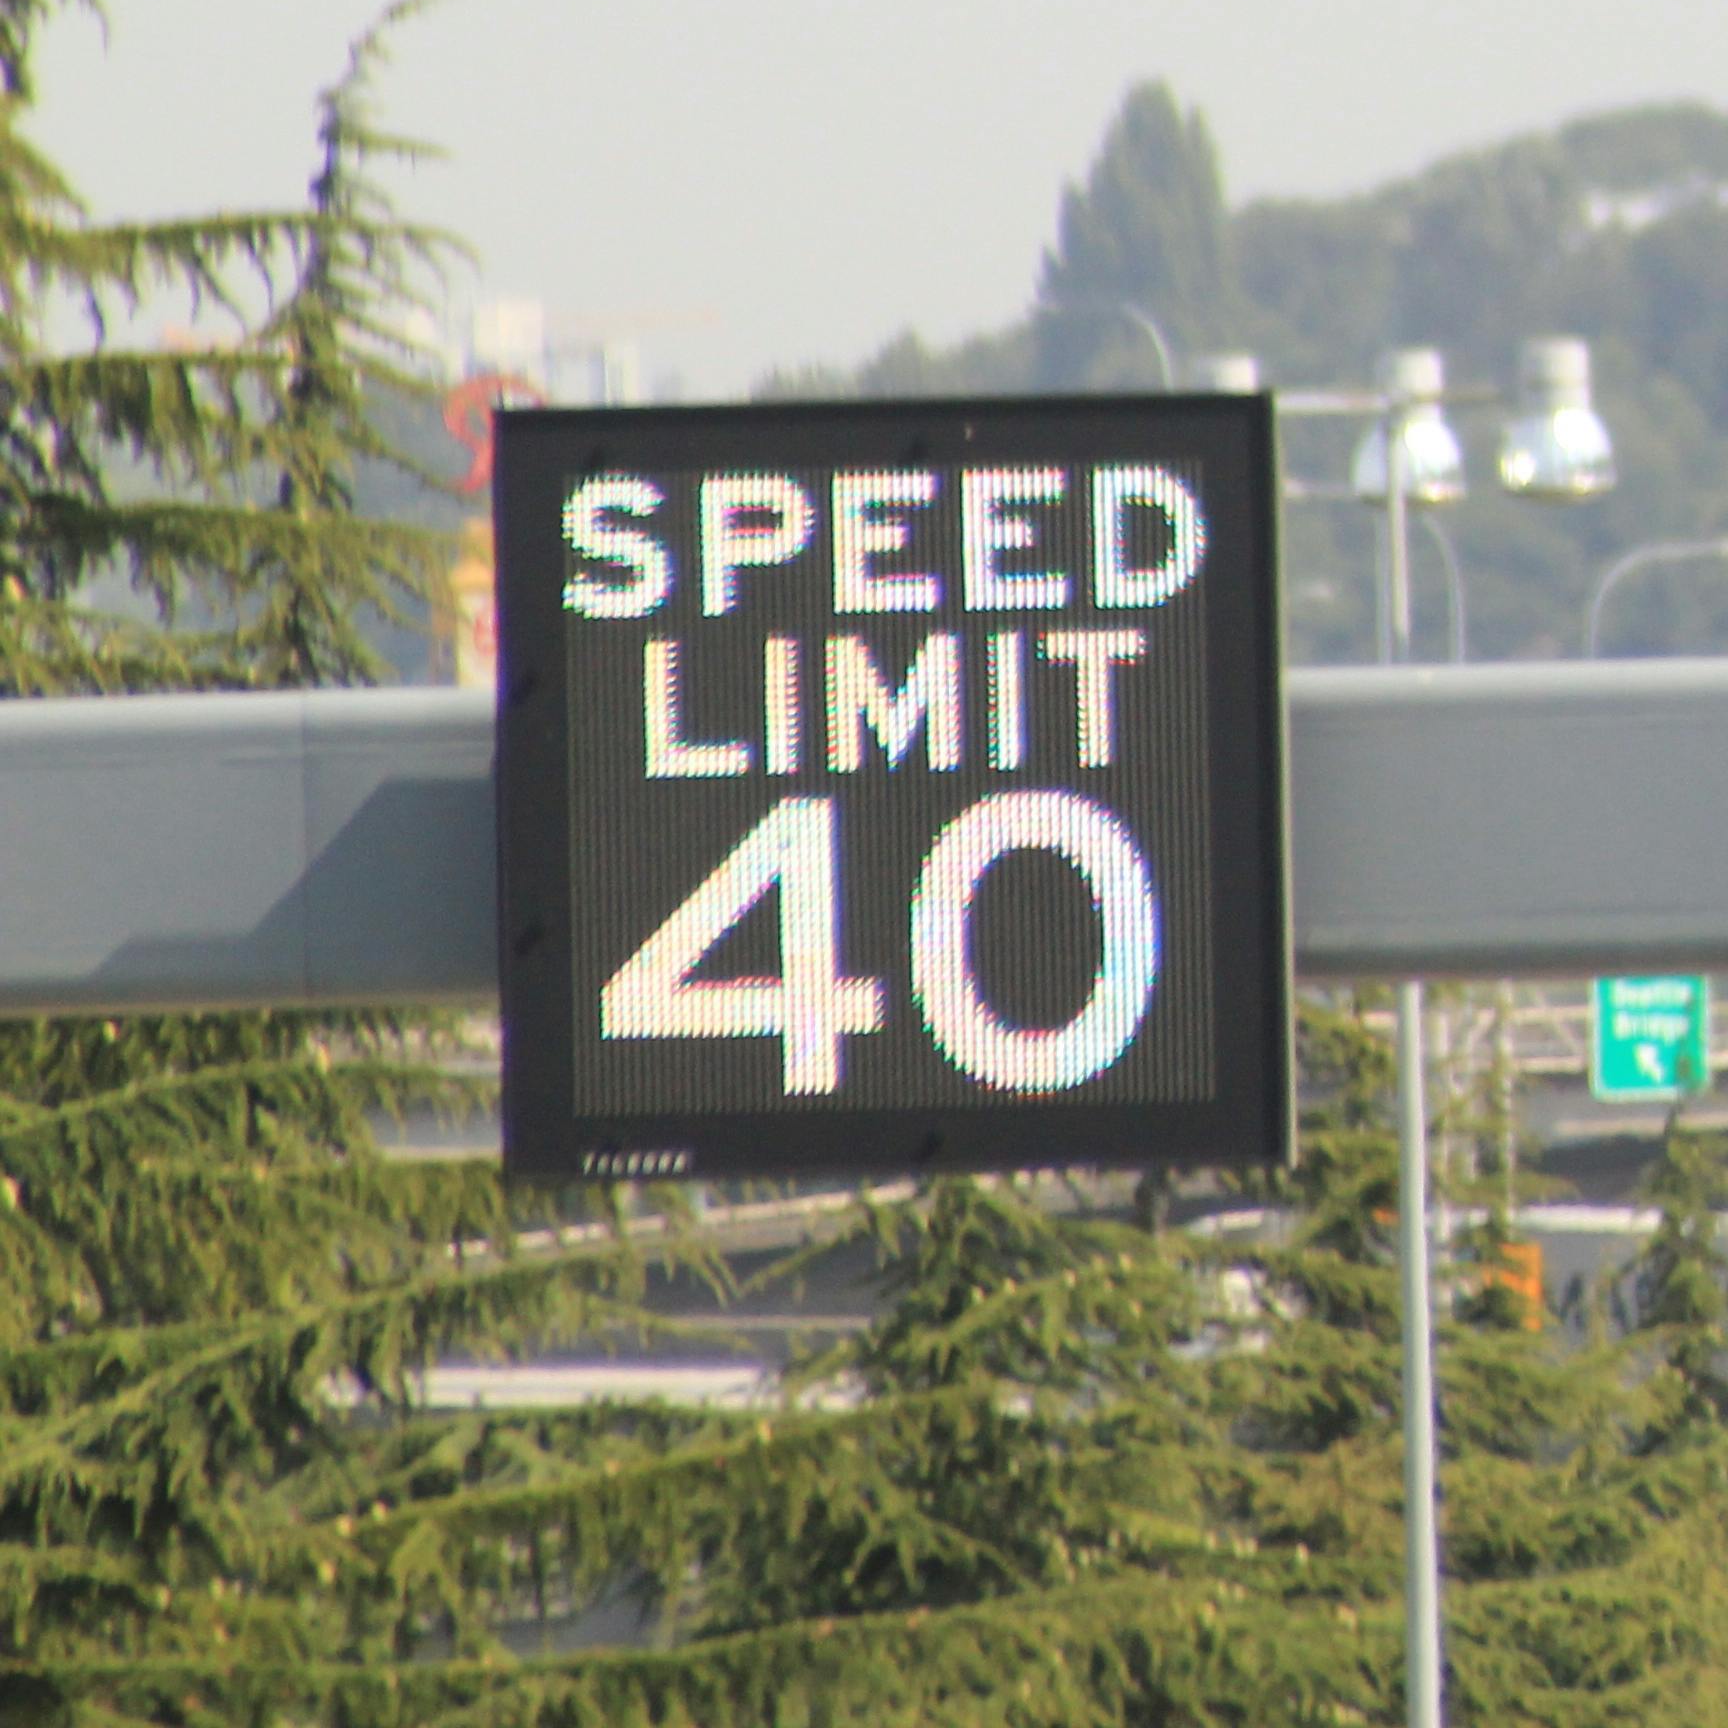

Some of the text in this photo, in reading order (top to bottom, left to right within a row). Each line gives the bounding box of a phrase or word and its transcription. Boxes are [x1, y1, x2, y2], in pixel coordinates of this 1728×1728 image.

[562, 463, 1207, 618] SPEED
[644, 629, 1147, 779] LIMIT
[600, 790, 1161, 1096] 40
